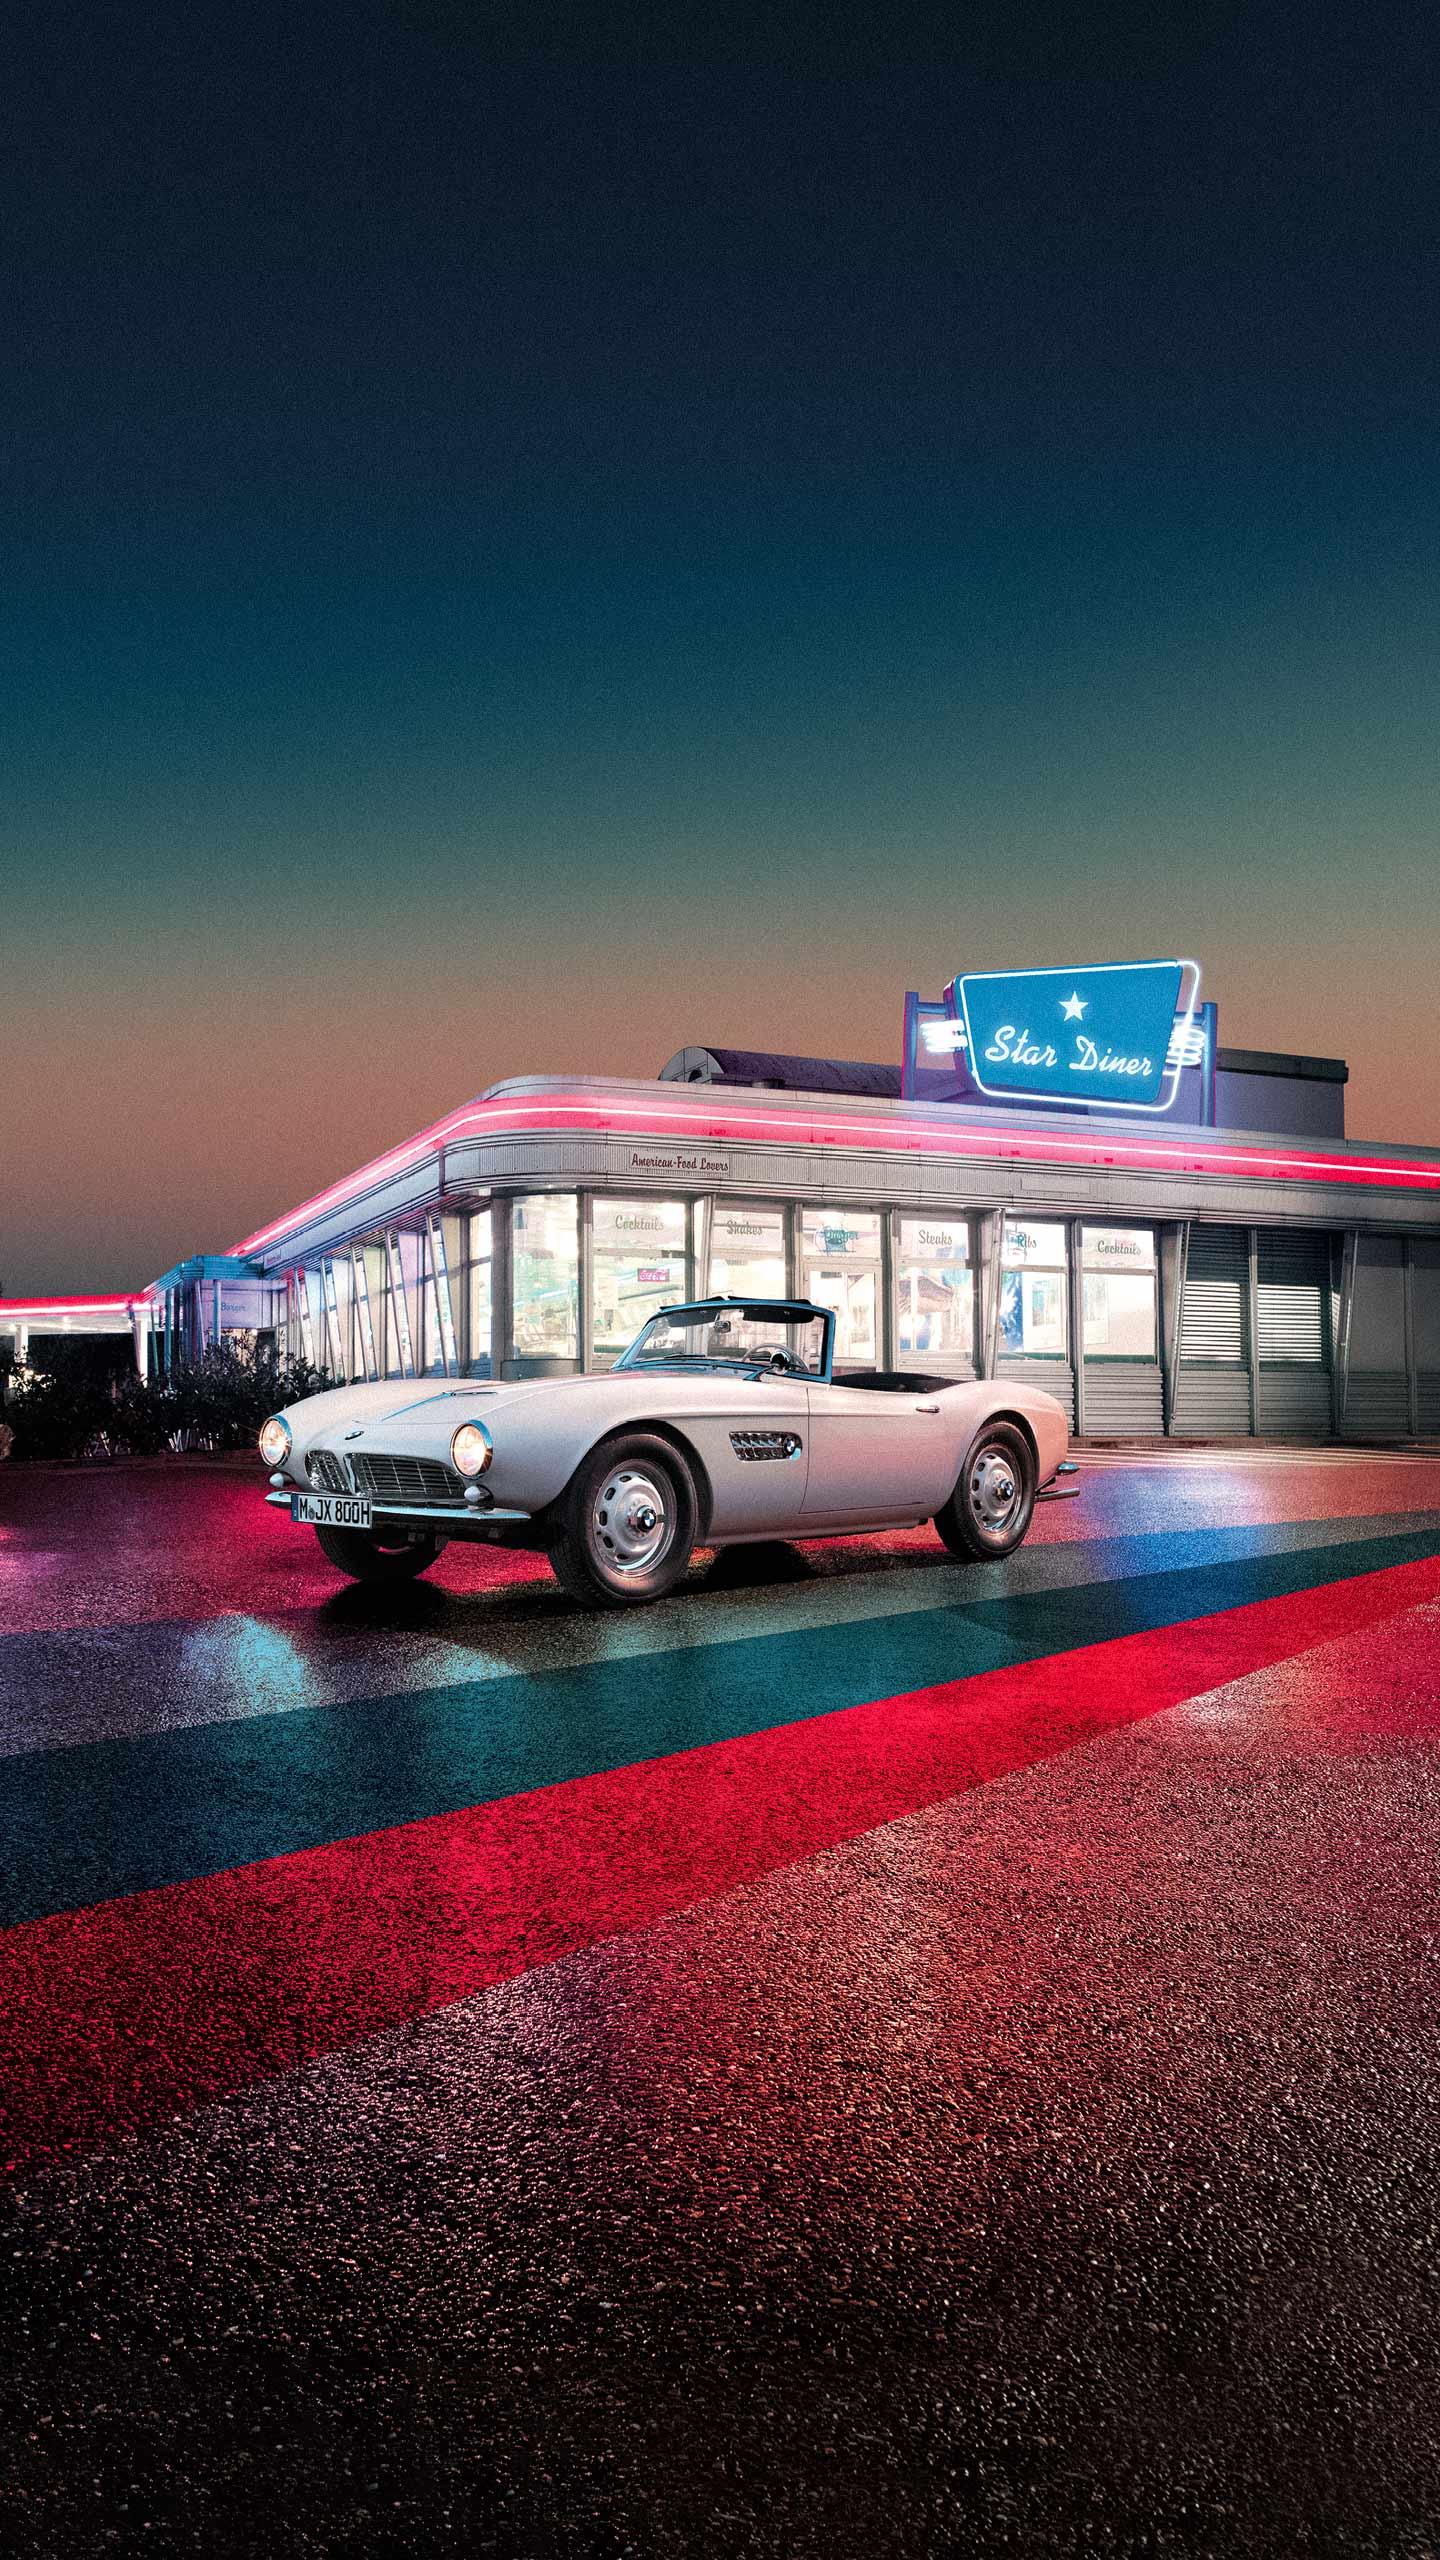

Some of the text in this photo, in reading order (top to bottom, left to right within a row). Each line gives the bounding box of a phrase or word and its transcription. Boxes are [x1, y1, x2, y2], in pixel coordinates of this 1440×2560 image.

[984, 1025, 1153, 1077] Star Diner
[631, 1153, 729, 1172] American-Food Lovers
[615, 1215, 664, 1231] Cocktails
[726, 1219, 764, 1235] Shakes
[918, 1230, 952, 1246] Steaks
[1016, 1233, 1037, 1248] Ribs
[1097, 1240, 1142, 1256] Cocktails
[299, 1498, 370, 1525] M JX 800H
